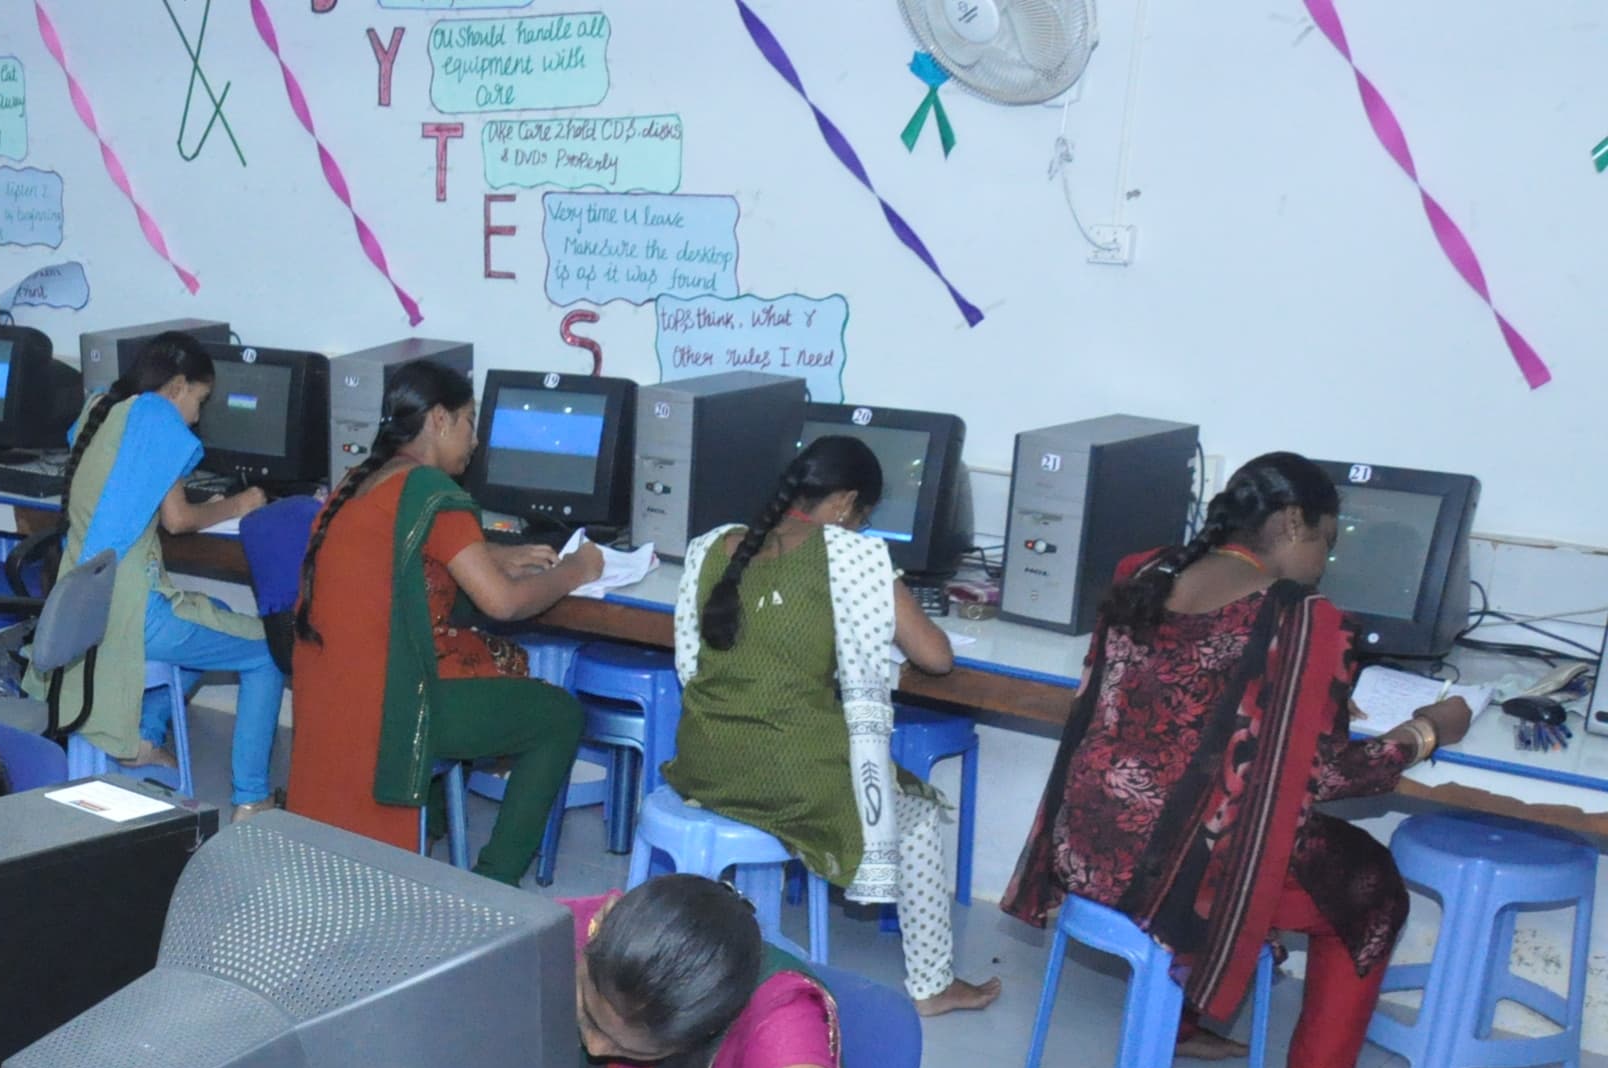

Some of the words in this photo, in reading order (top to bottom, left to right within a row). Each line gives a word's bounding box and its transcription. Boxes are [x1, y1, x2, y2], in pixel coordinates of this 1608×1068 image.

[517, 17, 572, 44] handle
[577, 14, 606, 39] all
[366, 27, 406, 107] Y
[443, 52, 533, 84] equipment
[542, 46, 588, 72] with
[421, 122, 464, 202] T
[586, 201, 618, 225] time
[643, 204, 685, 229] leave
[483, 194, 517, 280] E
[644, 238, 668, 261] the
[666, 266, 717, 292] found
[560, 309, 603, 376] S
[853, 409, 871, 423] 20
[1350, 465, 1369, 481] 21
